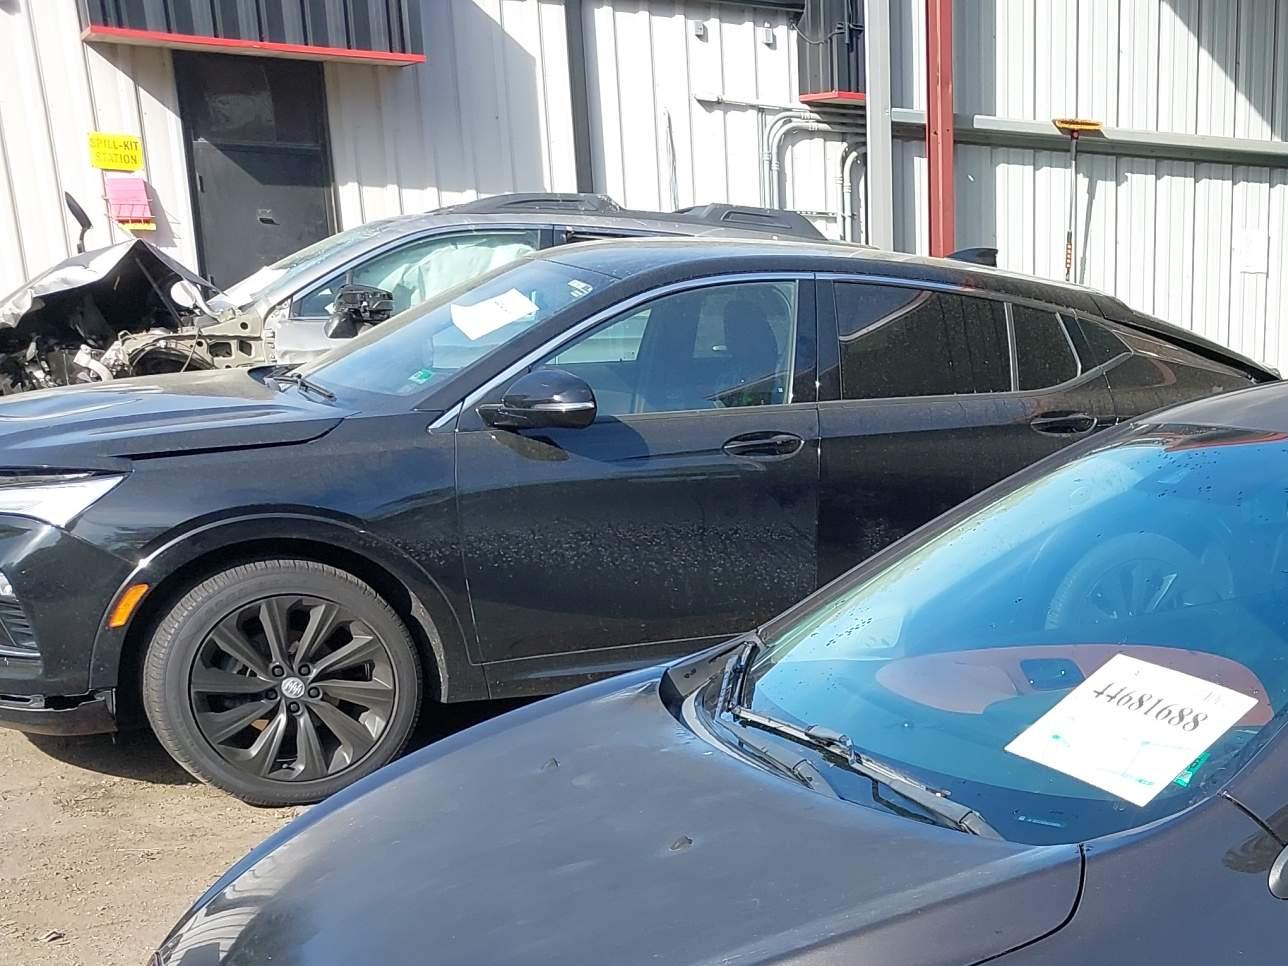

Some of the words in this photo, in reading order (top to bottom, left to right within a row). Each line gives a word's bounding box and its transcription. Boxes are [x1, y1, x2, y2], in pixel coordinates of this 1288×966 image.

[89, 137, 139, 151] SPILL-KIT
[96, 152, 138, 165] STATION
[1093, 682, 1208, 732] 44681688
